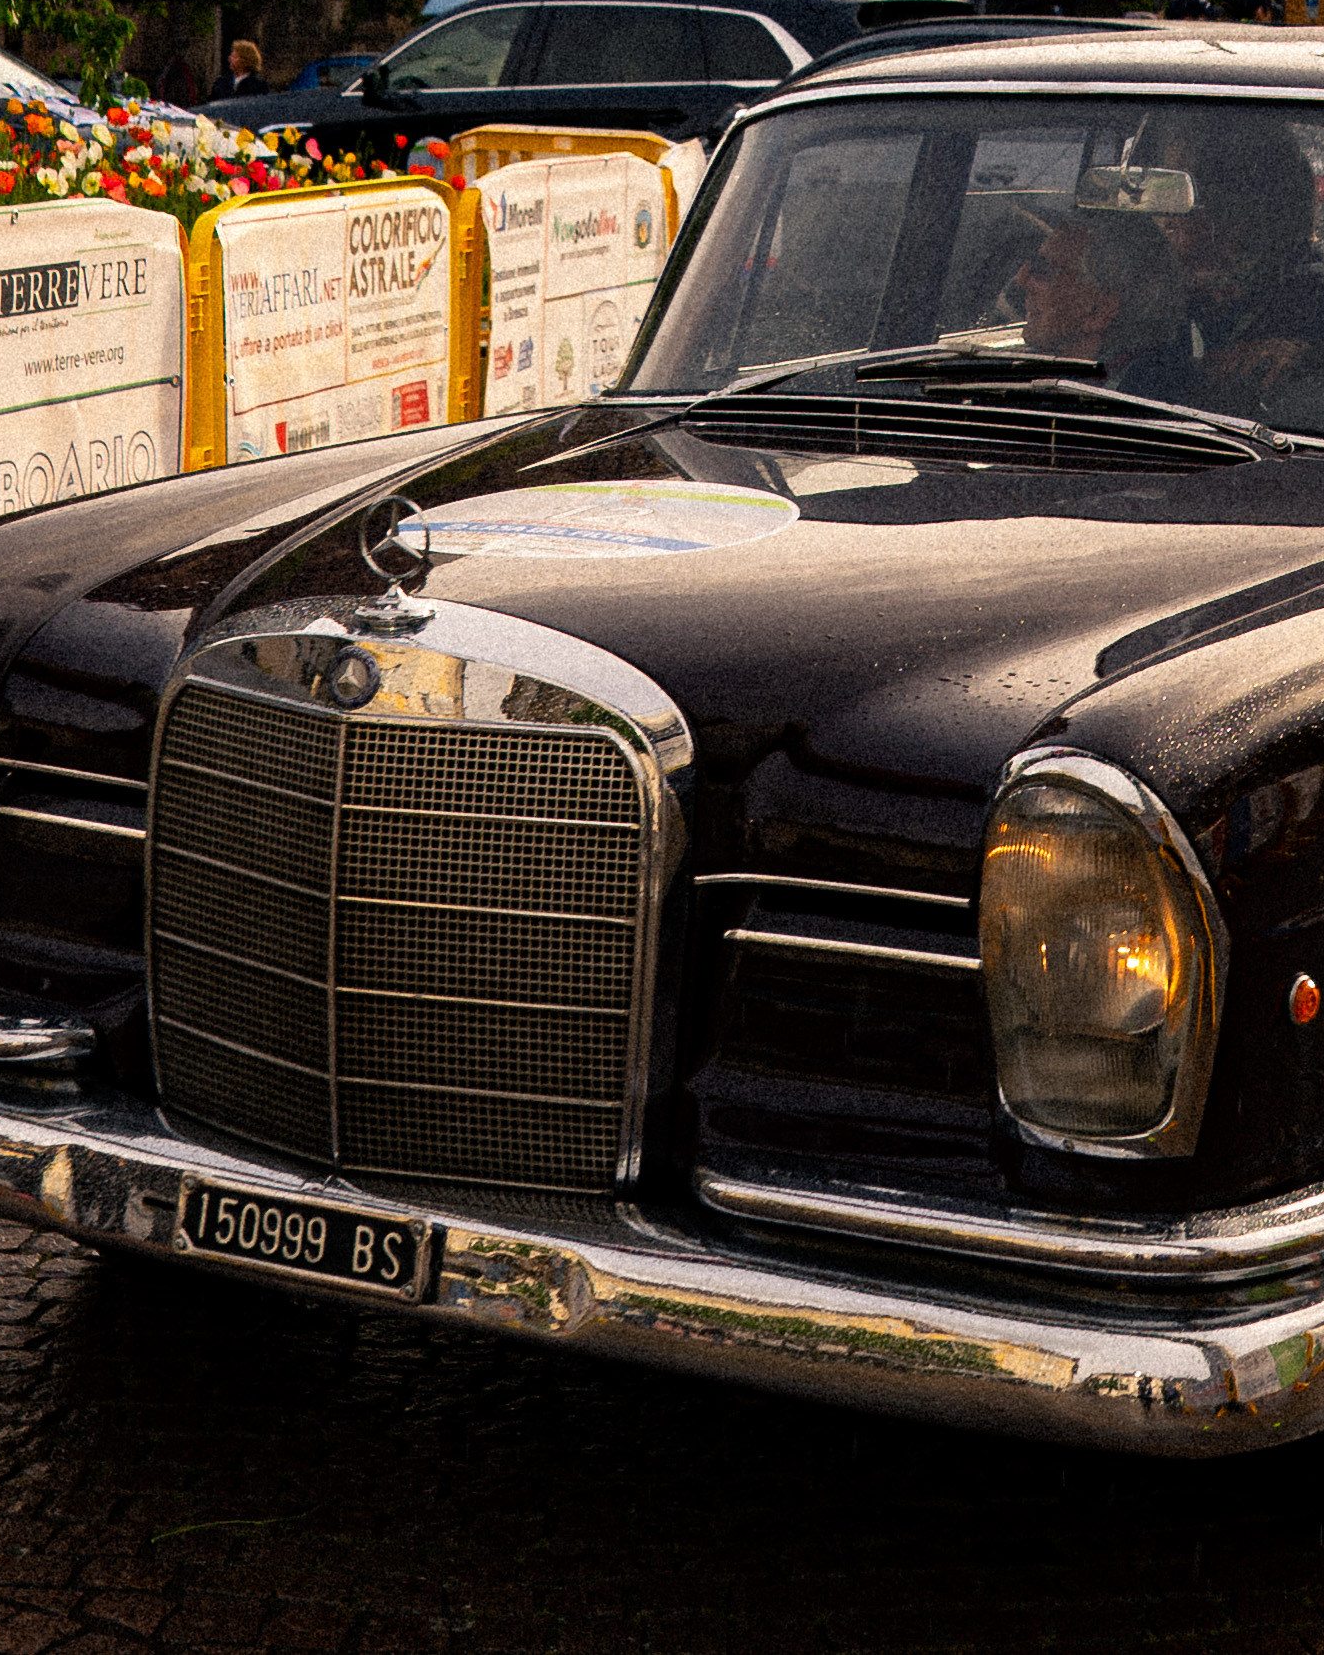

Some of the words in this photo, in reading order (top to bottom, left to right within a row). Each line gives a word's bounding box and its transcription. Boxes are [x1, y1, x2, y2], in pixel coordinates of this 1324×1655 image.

[350, 208, 442, 255] COLORIFICIO
[349, 251, 415, 298] ASTRALE
[24, 346, 124, 377] www.terre-vere.org
[199, 1192, 326, 1264] 150999
[352, 1225, 402, 1280] BS
